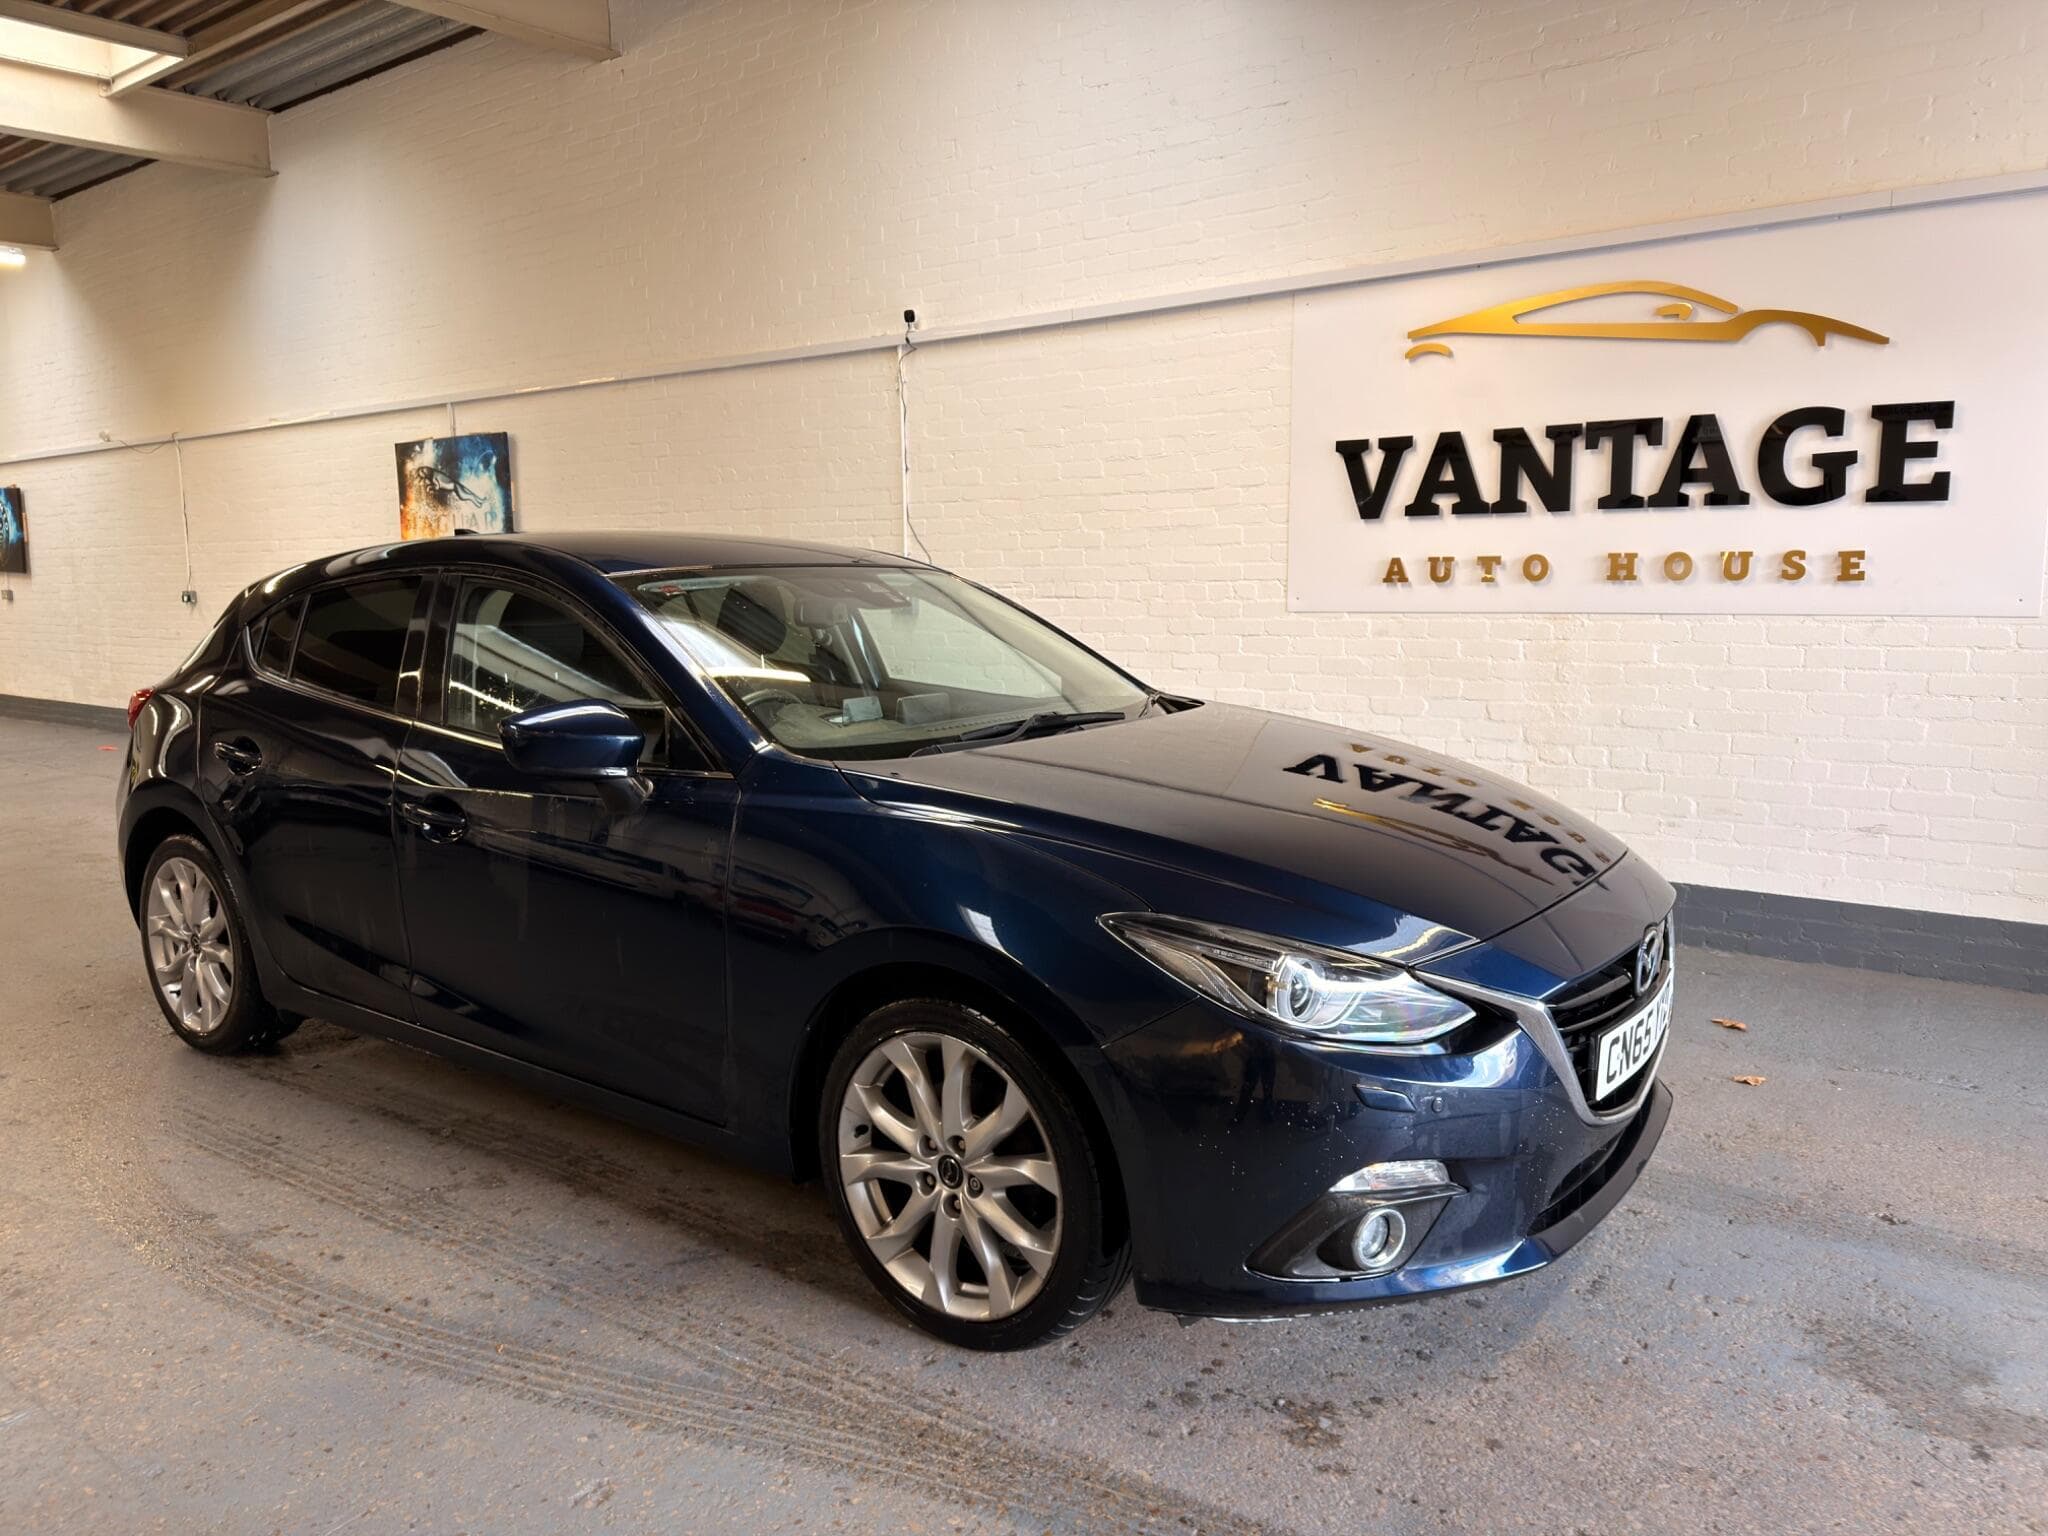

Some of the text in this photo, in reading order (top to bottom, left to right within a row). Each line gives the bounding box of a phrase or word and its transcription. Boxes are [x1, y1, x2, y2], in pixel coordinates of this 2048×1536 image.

[1335, 400, 1955, 520] VANTAGE
[1382, 549, 1866, 583] AUTO HOUSE
[1606, 1010, 1654, 1084] CN65
